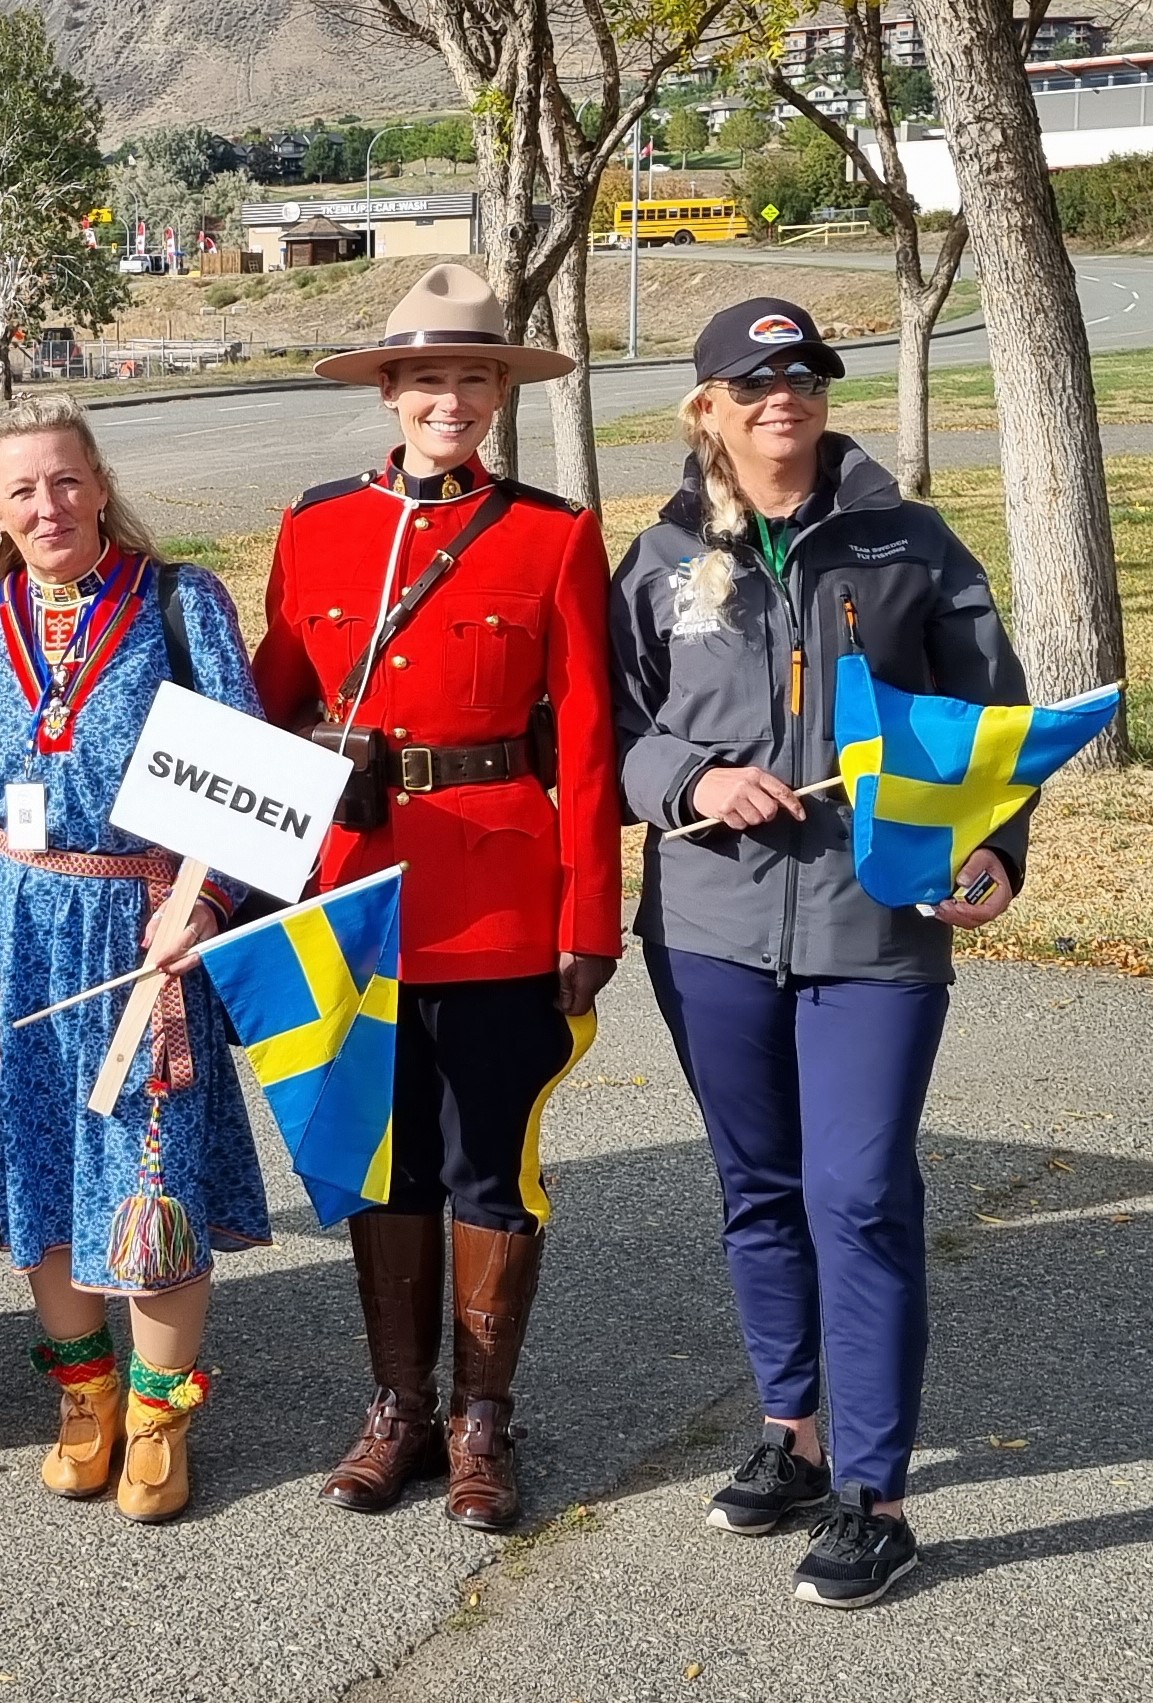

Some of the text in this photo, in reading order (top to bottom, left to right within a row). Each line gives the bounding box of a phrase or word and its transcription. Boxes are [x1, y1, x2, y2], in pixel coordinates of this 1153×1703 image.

[376, 202, 395, 212] CAR
[399, 201, 427, 211] WASH
[848, 539, 909, 553] TEAM SWEDEN
[871, 546, 906, 560] FISHING
[148, 751, 312, 839] SWEDEN
